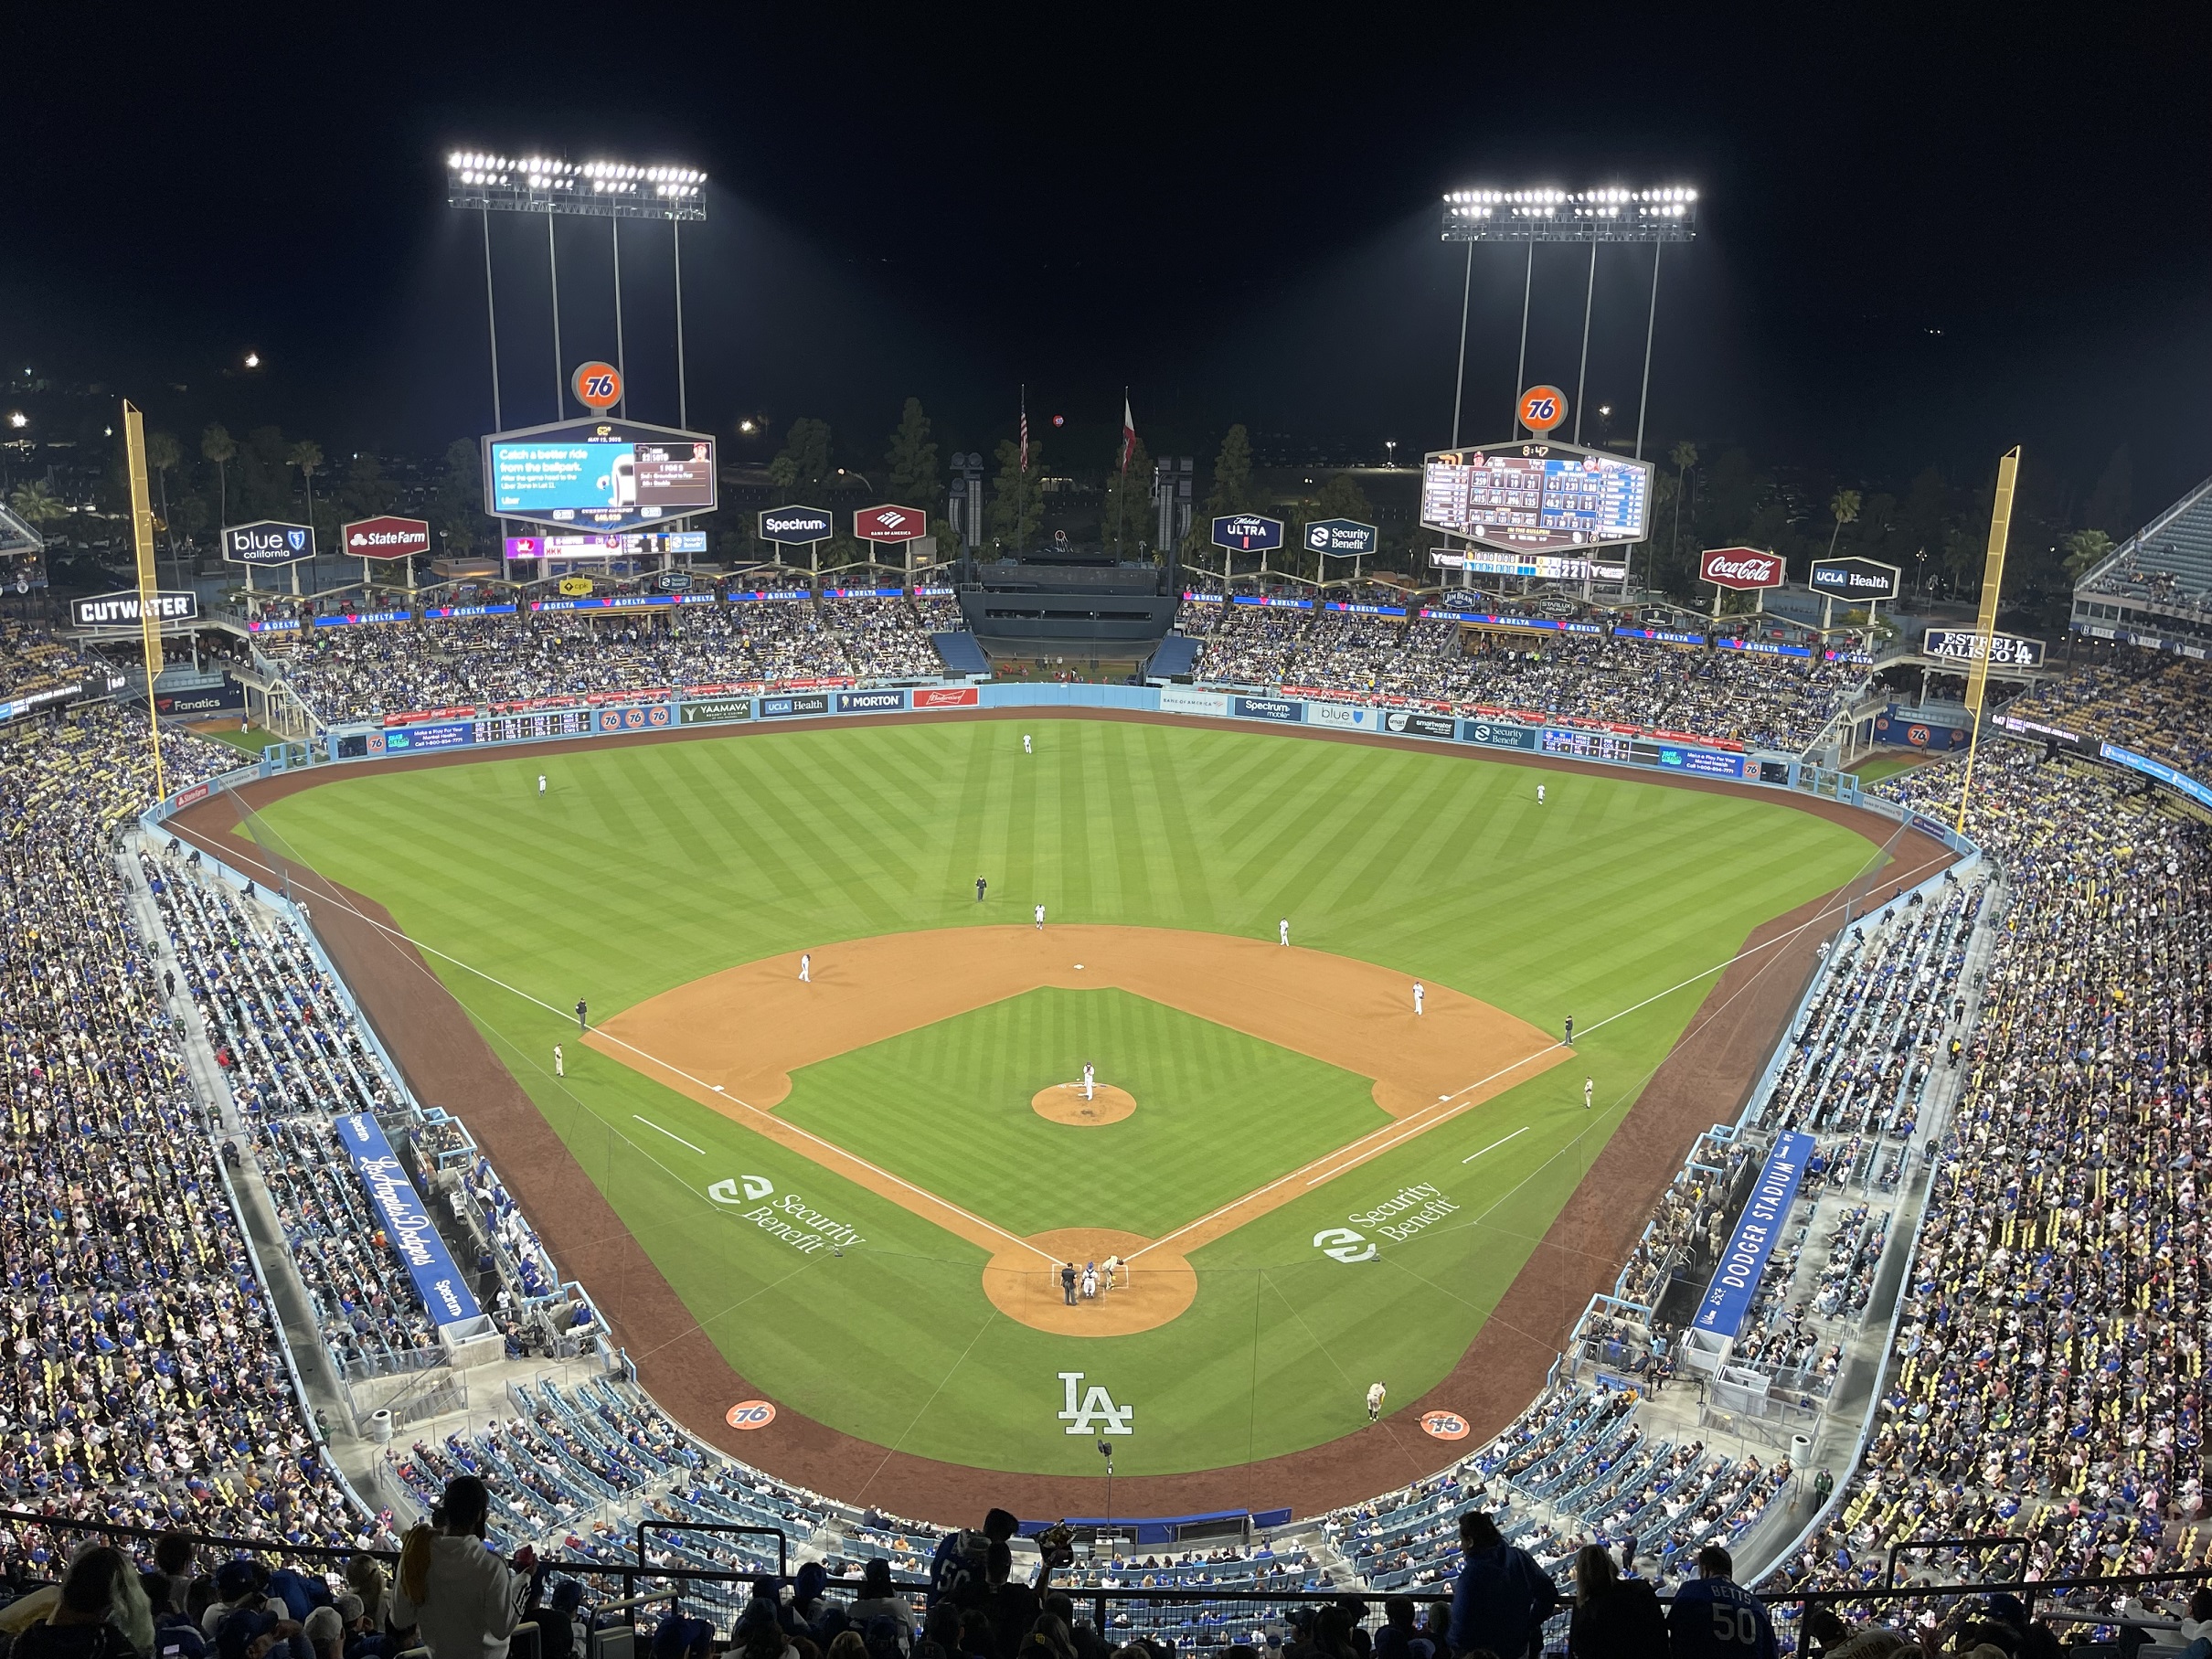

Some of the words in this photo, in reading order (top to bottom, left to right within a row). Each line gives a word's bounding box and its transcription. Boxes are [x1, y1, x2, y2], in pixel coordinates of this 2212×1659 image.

[586, 375, 614, 397] 76
[1526, 398, 1556, 420] 76
[499, 450, 528, 460] Catch
[537, 450, 568, 460] better
[569, 449, 588, 459] ride
[1523, 445, 1548, 457] 8:47
[500, 463, 524, 473] from
[525, 463, 541, 473] the
[542, 462, 582, 473] ballpark.
[1527, 480, 1535, 488] 21
[1565, 483, 1579, 491] 2.31
[501, 496, 520, 505] Uber
[1473, 495, 1485, 503] .415
[1525, 497, 1536, 506] 135
[1566, 500, 1575, 509] 32
[1585, 501, 1592, 510] 15
[766, 518, 823, 533] Spectrum
[1227, 525, 1266, 537] ULTRA
[1332, 527, 1369, 541] Security
[235, 531, 283, 550] blue
[683, 536, 704, 545] Security
[1332, 538, 1364, 549] Benefit
[243, 549, 290, 559] california
[1816, 571, 1844, 583] UCLA
[1849, 573, 1888, 589] Health
[1445, 593, 1456, 603] JIM
[1457, 592, 1473, 604] BEAM
[81, 597, 188, 622] CUTWATER
[550, 601, 574, 610] DELTA
[1541, 601, 1570, 610] STARLUX
[272, 620, 300, 630] DELTA
[1577, 624, 1601, 633] DELTA
[1754, 644, 1778, 653] DELTA
[1934, 643, 2010, 662] JALISCO
[1846, 654, 1873, 665] ELTA
[854, 696, 899, 707] MORTON
[931, 692, 962, 701] Budweiser
[175, 697, 221, 711] Fanatics
[768, 703, 788, 711] UCLA
[793, 700, 823, 710] Health
[1245, 700, 1288, 714] Spectrum
[630, 713, 642, 722] 76
[654, 710, 665, 720] 76
[1267, 710, 1287, 718] mobile
[1322, 707, 1350, 720] blue
[604, 716, 617, 725] 76
[1416, 719, 1452, 729] smartwater
[1493, 727, 1524, 740] Security
[1910, 728, 1927, 740] 76
[370, 738, 383, 749] 76
[1493, 734, 1520, 746] Benefit
[1746, 765, 1758, 774] 76
[350, 1115, 369, 1142] Spectrum
[360, 1155, 399, 1181] Los
[374, 1173, 412, 1219] Angeles
[1348, 1181, 1441, 1228] Security
[771, 1194, 867, 1247] Security
[1376, 1198, 1461, 1241] Benefit
[1722, 1224, 1767, 1289] DODGER
[1752, 1162, 1796, 1220] STADIUM
[742, 1206, 824, 1254] Benefit
[395, 1215, 435, 1266] Dodgers
[434, 1279, 462, 1316] Spectrum
[1057, 1371, 1134, 1435] LA
[732, 1406, 769, 1423] 76
[1429, 1415, 1465, 1433] 76
[1711, 1584, 1752, 1605] BETTS
[1712, 1601, 1756, 1645] 50
